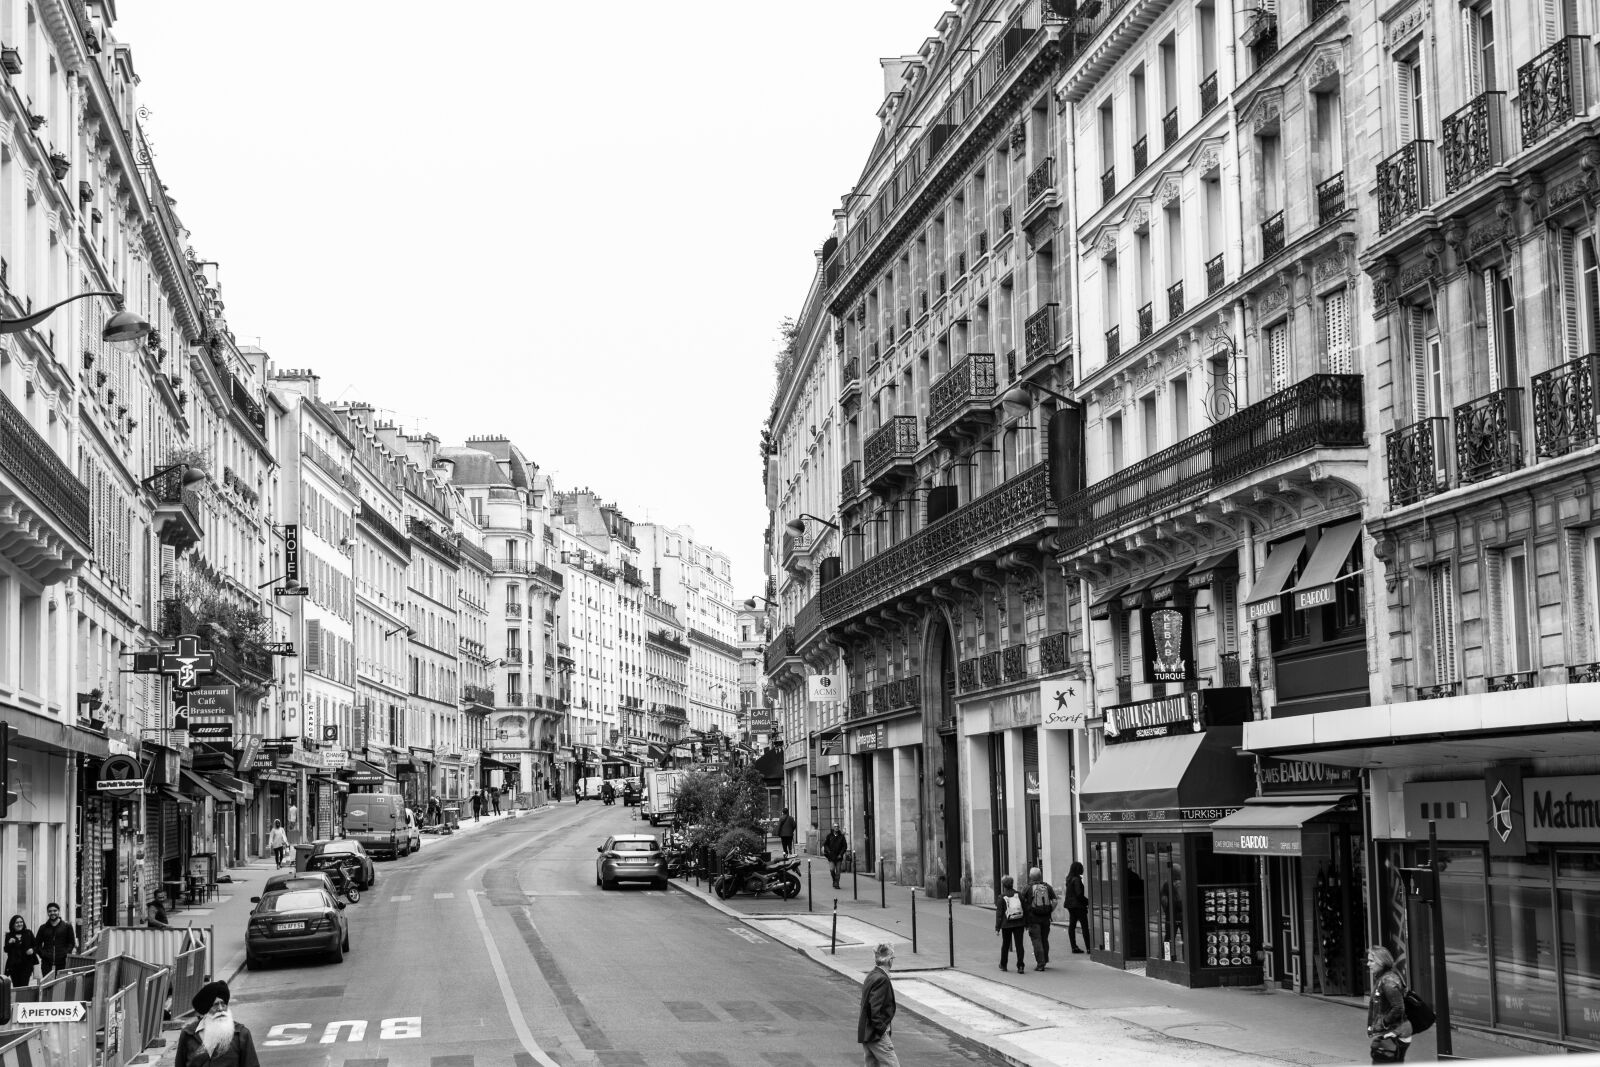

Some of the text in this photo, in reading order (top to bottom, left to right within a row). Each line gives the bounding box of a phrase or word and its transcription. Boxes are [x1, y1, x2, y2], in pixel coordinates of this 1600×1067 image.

[286, 528, 297, 578] HOTE
[1300, 588, 1330, 607] BARDOU
[1250, 600, 1276, 618] BARDOU
[1163, 614, 1172, 657] KEBAB
[1154, 672, 1186, 681] TURQUE
[814, 688, 837, 696] ACMS
[198, 697, 216, 705] Café
[190, 707, 226, 715] Brasserie
[1280, 761, 1324, 782] BARDOU
[1182, 809, 1223, 819] TURKISH
[1240, 835, 1269, 849] BARDOU
[28, 1008, 72, 1016] PIETONS
[262, 1015, 422, 1047] BUS
